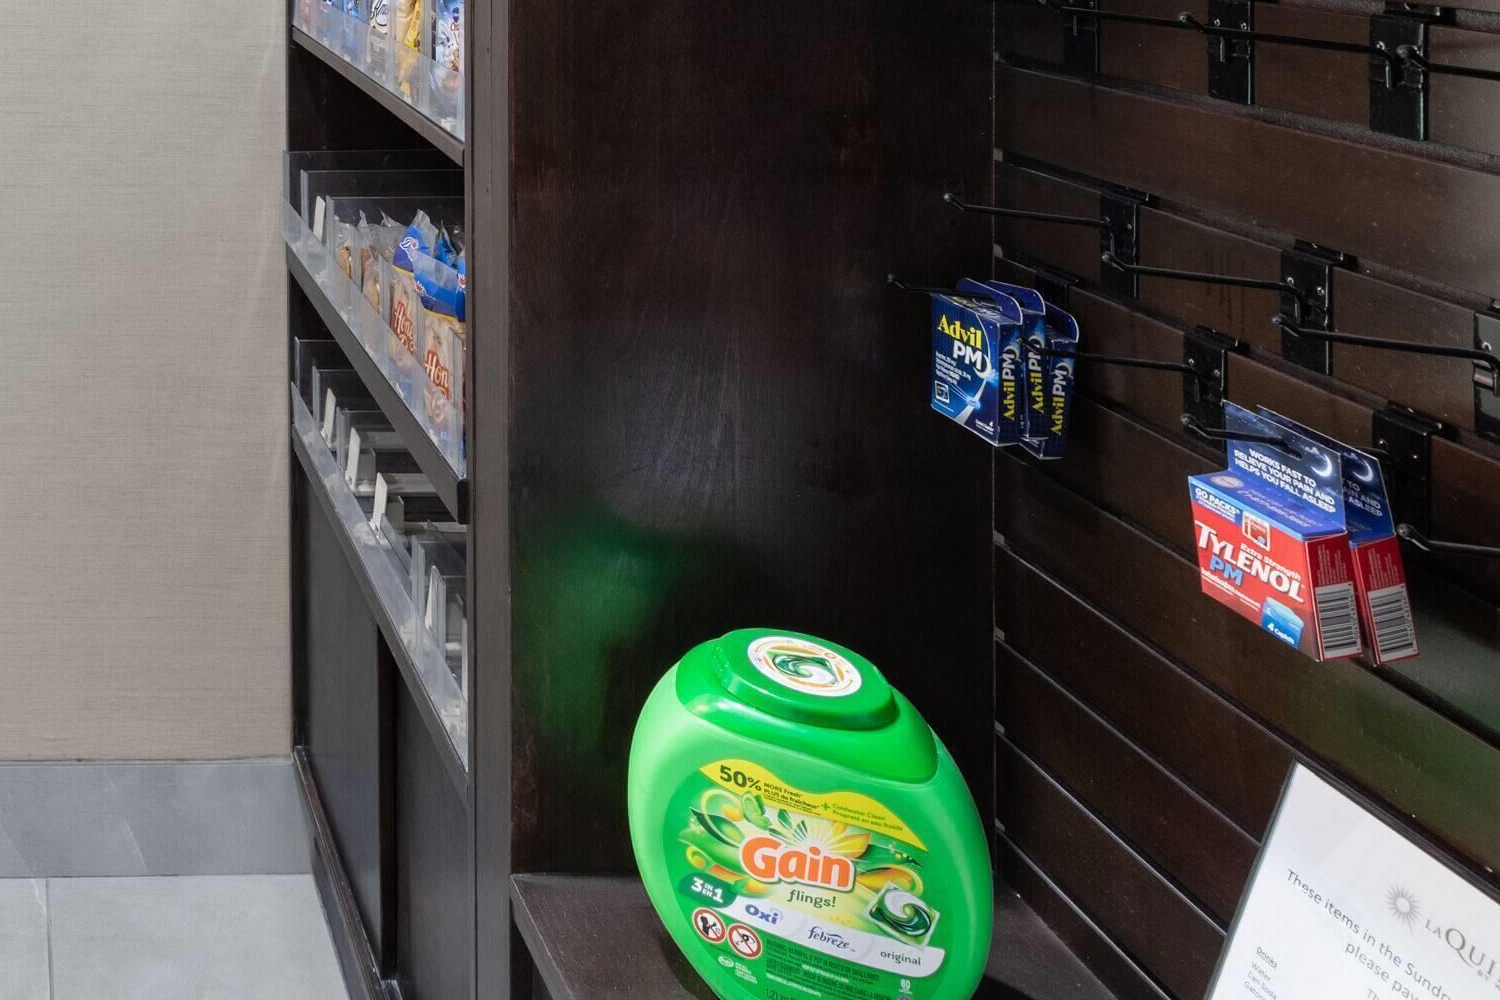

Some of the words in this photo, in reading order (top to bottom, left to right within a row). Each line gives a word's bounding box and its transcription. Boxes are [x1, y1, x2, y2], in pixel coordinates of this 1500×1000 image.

[938, 314, 982, 349] Advil
[953, 340, 983, 371] PM
[1002, 353, 1015, 380] PM
[1030, 372, 1044, 414] Advil
[1052, 369, 1067, 396] PM
[1003, 381, 1015, 421] Advil
[1051, 397, 1065, 436] Advil
[1234, 449, 1267, 473] RELIEVE
[1268, 466, 1292, 486] YOUR
[1293, 479, 1314, 496] PAIN
[1315, 490, 1335, 506] AND
[1249, 448, 1281, 471] WORKS
[1281, 465, 1301, 481] FAST
[1304, 475, 1316, 488] TO
[1235, 458, 1260, 477] HELPS
[1262, 472, 1279, 486] YOU
[1280, 481, 1300, 497] FALL
[1302, 494, 1336, 514] ASLEEP
[1195, 487, 1208, 498] GO
[1208, 492, 1236, 515] PACKS
[1349, 498, 1382, 517] ASLEEP
[1361, 494, 1381, 510] AND
[1195, 519, 1304, 604] TYLENOL
[1209, 555, 1244, 587] PM
[1240, 543, 1263, 560] Extra
[1263, 555, 1302, 580] Strength
[1267, 623, 1275, 632] 4
[719, 765, 762, 792] 50%
[764, 782, 782, 793] MORE
[764, 789, 780, 798] PLUS
[832, 803, 866, 817] Coldwater
[867, 810, 886, 821] Clean
[743, 838, 852, 888] Gain
[691, 877, 701, 892] 3
[704, 883, 713, 891] IN
[713, 888, 723, 903] 1
[702, 889, 713, 898] EN
[787, 889, 836, 909] flings!
[745, 904, 779, 925] Oxi
[1287, 869, 1322, 904] These
[1324, 899, 1360, 934] items
[1363, 928, 1376, 947] in
[1379, 942, 1402, 967] the
[808, 926, 850, 949] febreze
[1425, 919, 1441, 939] LA
[880, 951, 921, 966] original
[1256, 946, 1278, 968] Drinks
[1345, 943, 1390, 982] please
[1251, 961, 1271, 982] Water
[1247, 971, 1260, 985] Can
[1261, 982, 1277, 1000] Soda
